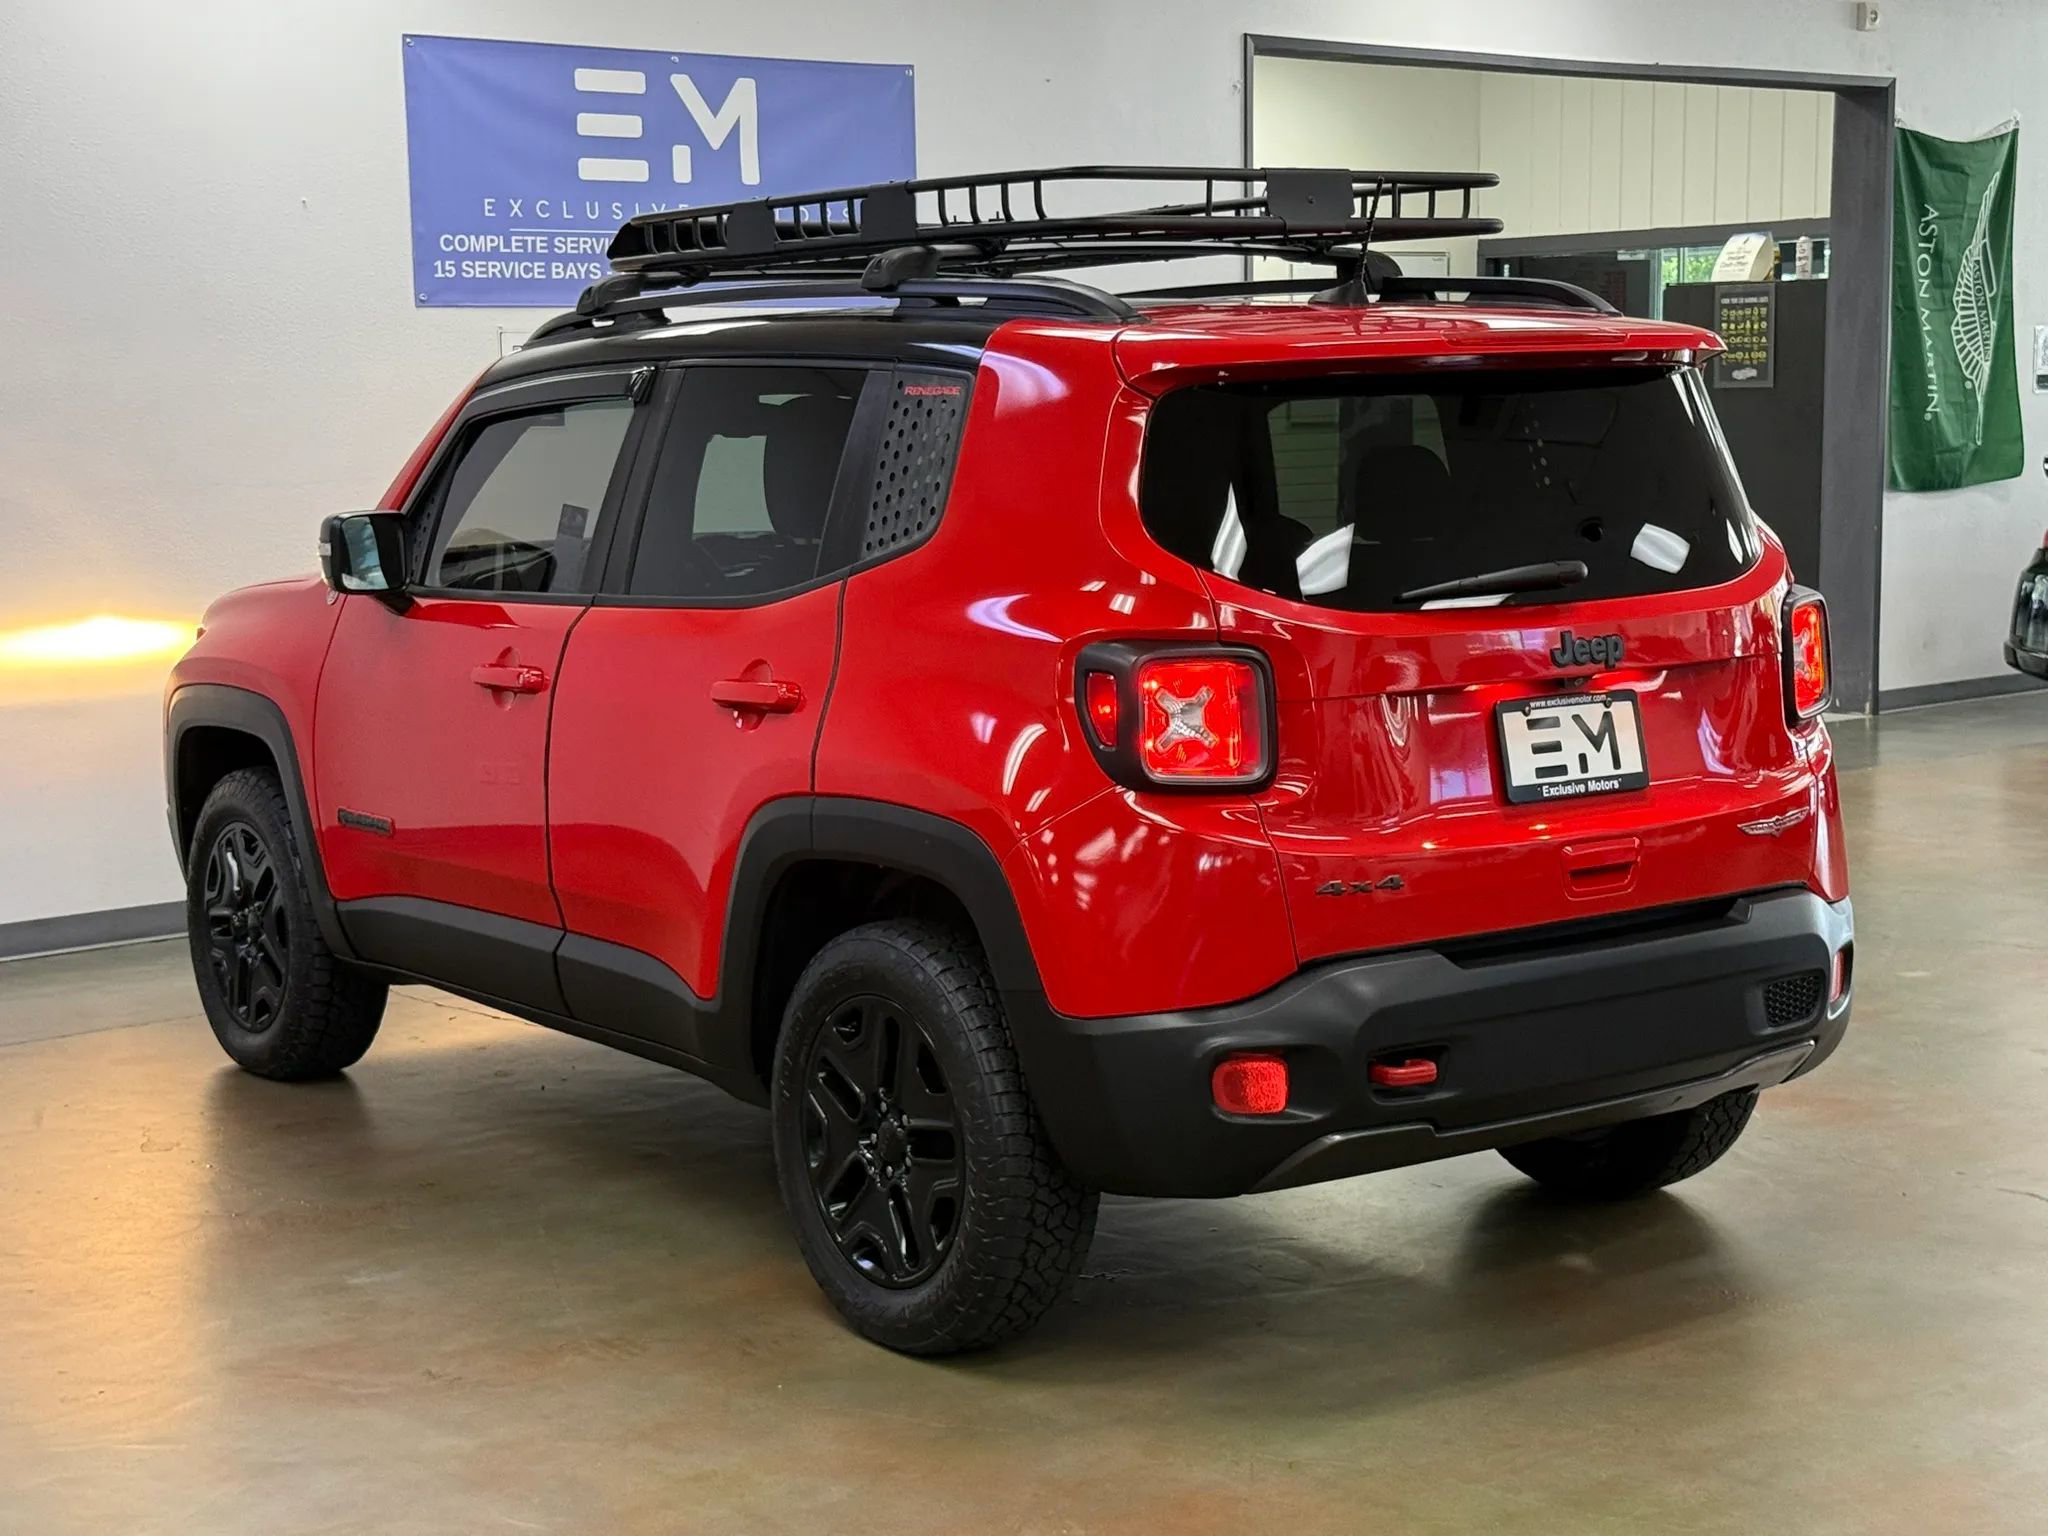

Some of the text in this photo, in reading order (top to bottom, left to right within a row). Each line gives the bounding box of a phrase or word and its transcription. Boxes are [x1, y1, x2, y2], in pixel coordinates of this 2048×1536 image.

[574, 68, 760, 185] EM
[484, 198, 689, 220] EXCLUSIV
[439, 234, 615, 254] COMPLETE SERVI
[1916, 203, 1940, 298] ASTON
[434, 260, 456, 278] 15
[461, 261, 546, 279] SERVICE
[551, 263, 601, 279] BAYS
[1973, 262, 1986, 306] ASTON
[1979, 310, 1991, 361] MARTIN
[1920, 307, 1941, 413] MARTIN
[904, 386, 961, 396] RENEGADE
[1550, 630, 1624, 668] Jeep
[1529, 694, 1607, 710] www.exclusivemotor.com
[1526, 711, 1622, 779] EM
[1543, 779, 1620, 797] Exclusive Motors
